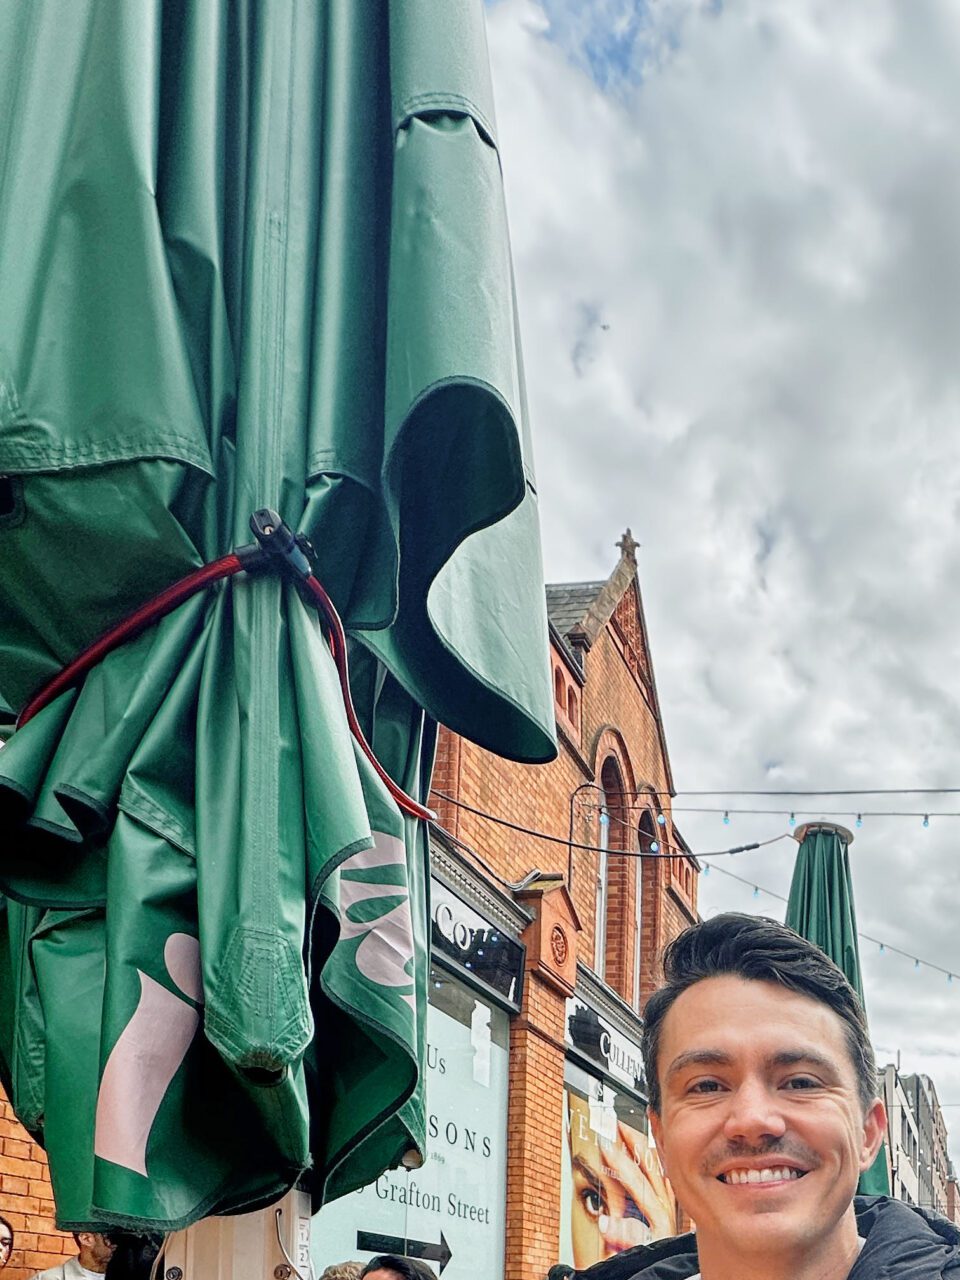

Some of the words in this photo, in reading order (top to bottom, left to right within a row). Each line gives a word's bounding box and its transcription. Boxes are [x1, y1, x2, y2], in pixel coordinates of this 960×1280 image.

[428, 1114, 491, 1158] SONS
[375, 1173, 442, 1213] Grafton
[448, 1192, 490, 1225] Street
